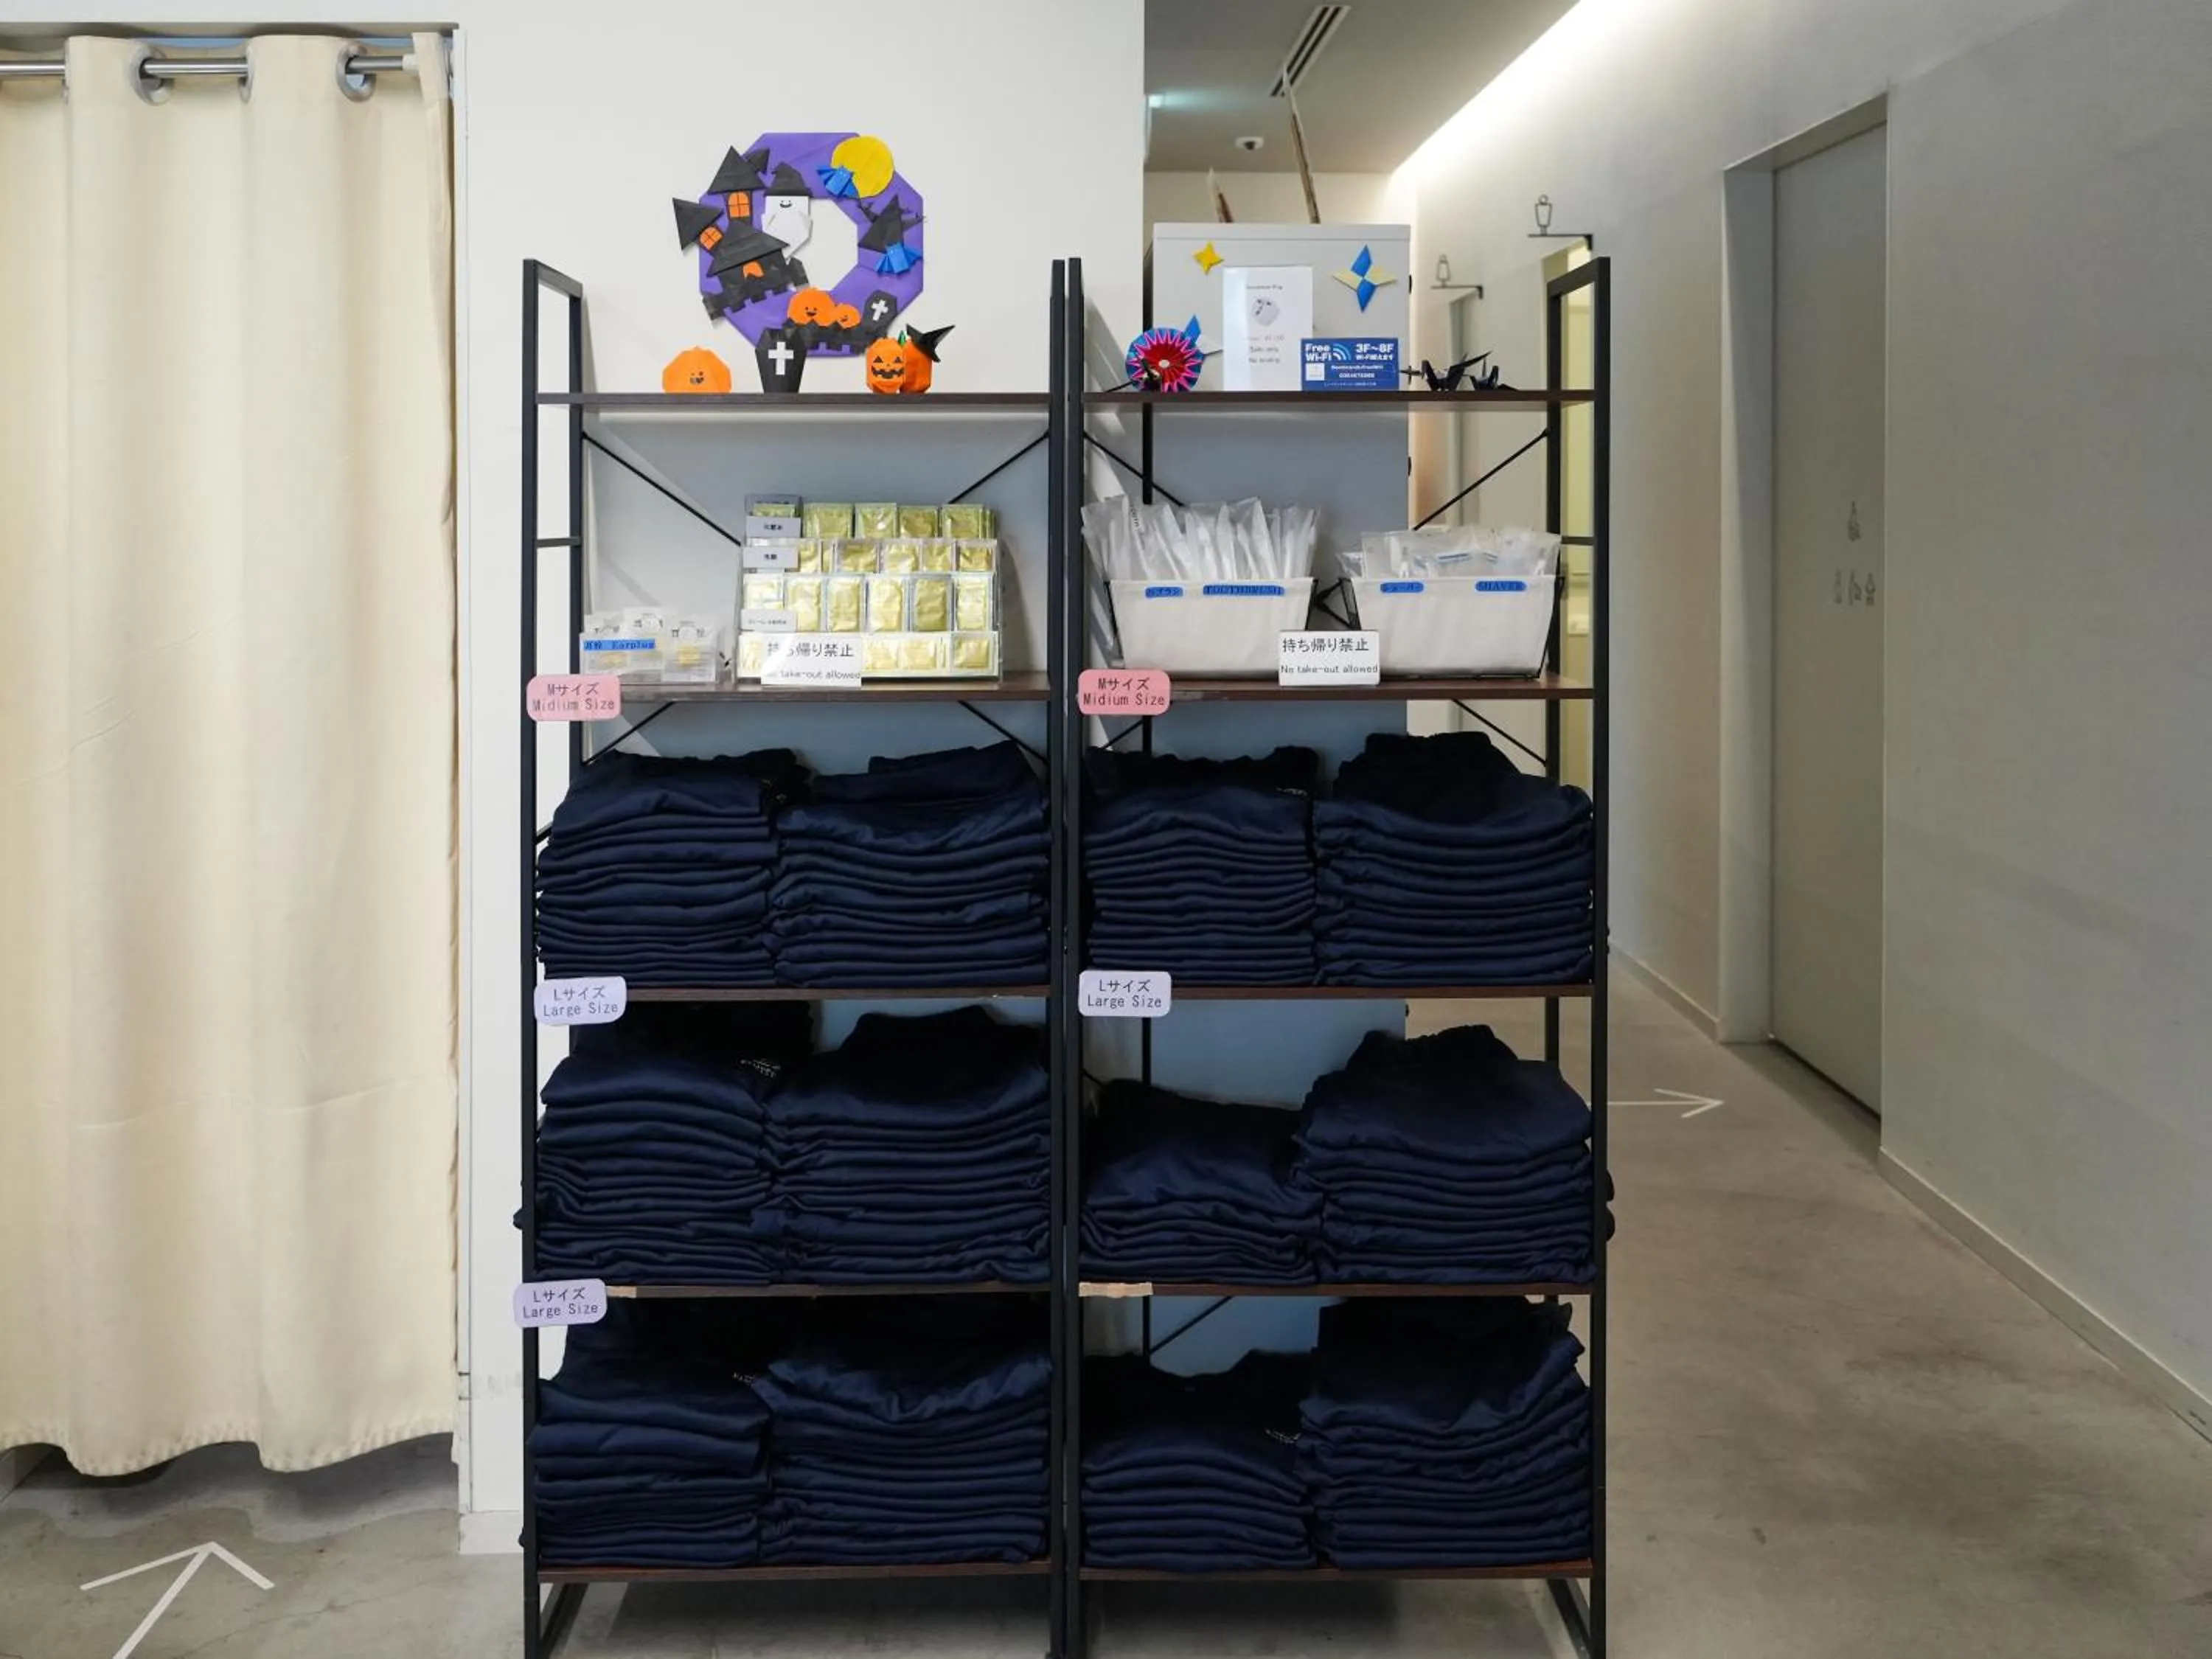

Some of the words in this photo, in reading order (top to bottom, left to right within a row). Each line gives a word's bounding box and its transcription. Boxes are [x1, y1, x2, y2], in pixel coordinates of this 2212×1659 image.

[1305, 343, 1330, 352] Free
[1282, 637, 1369, 653] 持ち帰り禁止
[825, 669, 861, 679] allowed
[1281, 664, 1294, 673] No
[1298, 664, 1339, 673] take-out
[1343, 664, 1377, 673] allowed
[548, 682, 599, 696] Mサイズ
[1098, 677, 1150, 691] Mサイズ
[532, 699, 579, 712] Midium
[585, 698, 614, 710] Size
[1083, 692, 1129, 706] Midium
[1135, 692, 1165, 706] Size
[1099, 978, 1151, 992] Lサイズ
[554, 985, 605, 1001] Lサイズ
[1088, 994, 1124, 1009] Large
[1132, 995, 1161, 1008] Size
[543, 1004, 580, 1017] Large
[589, 1001, 618, 1014] Size
[533, 1287, 585, 1302] Lサイズ
[523, 1305, 560, 1318] Large
[568, 1303, 598, 1315] Size
